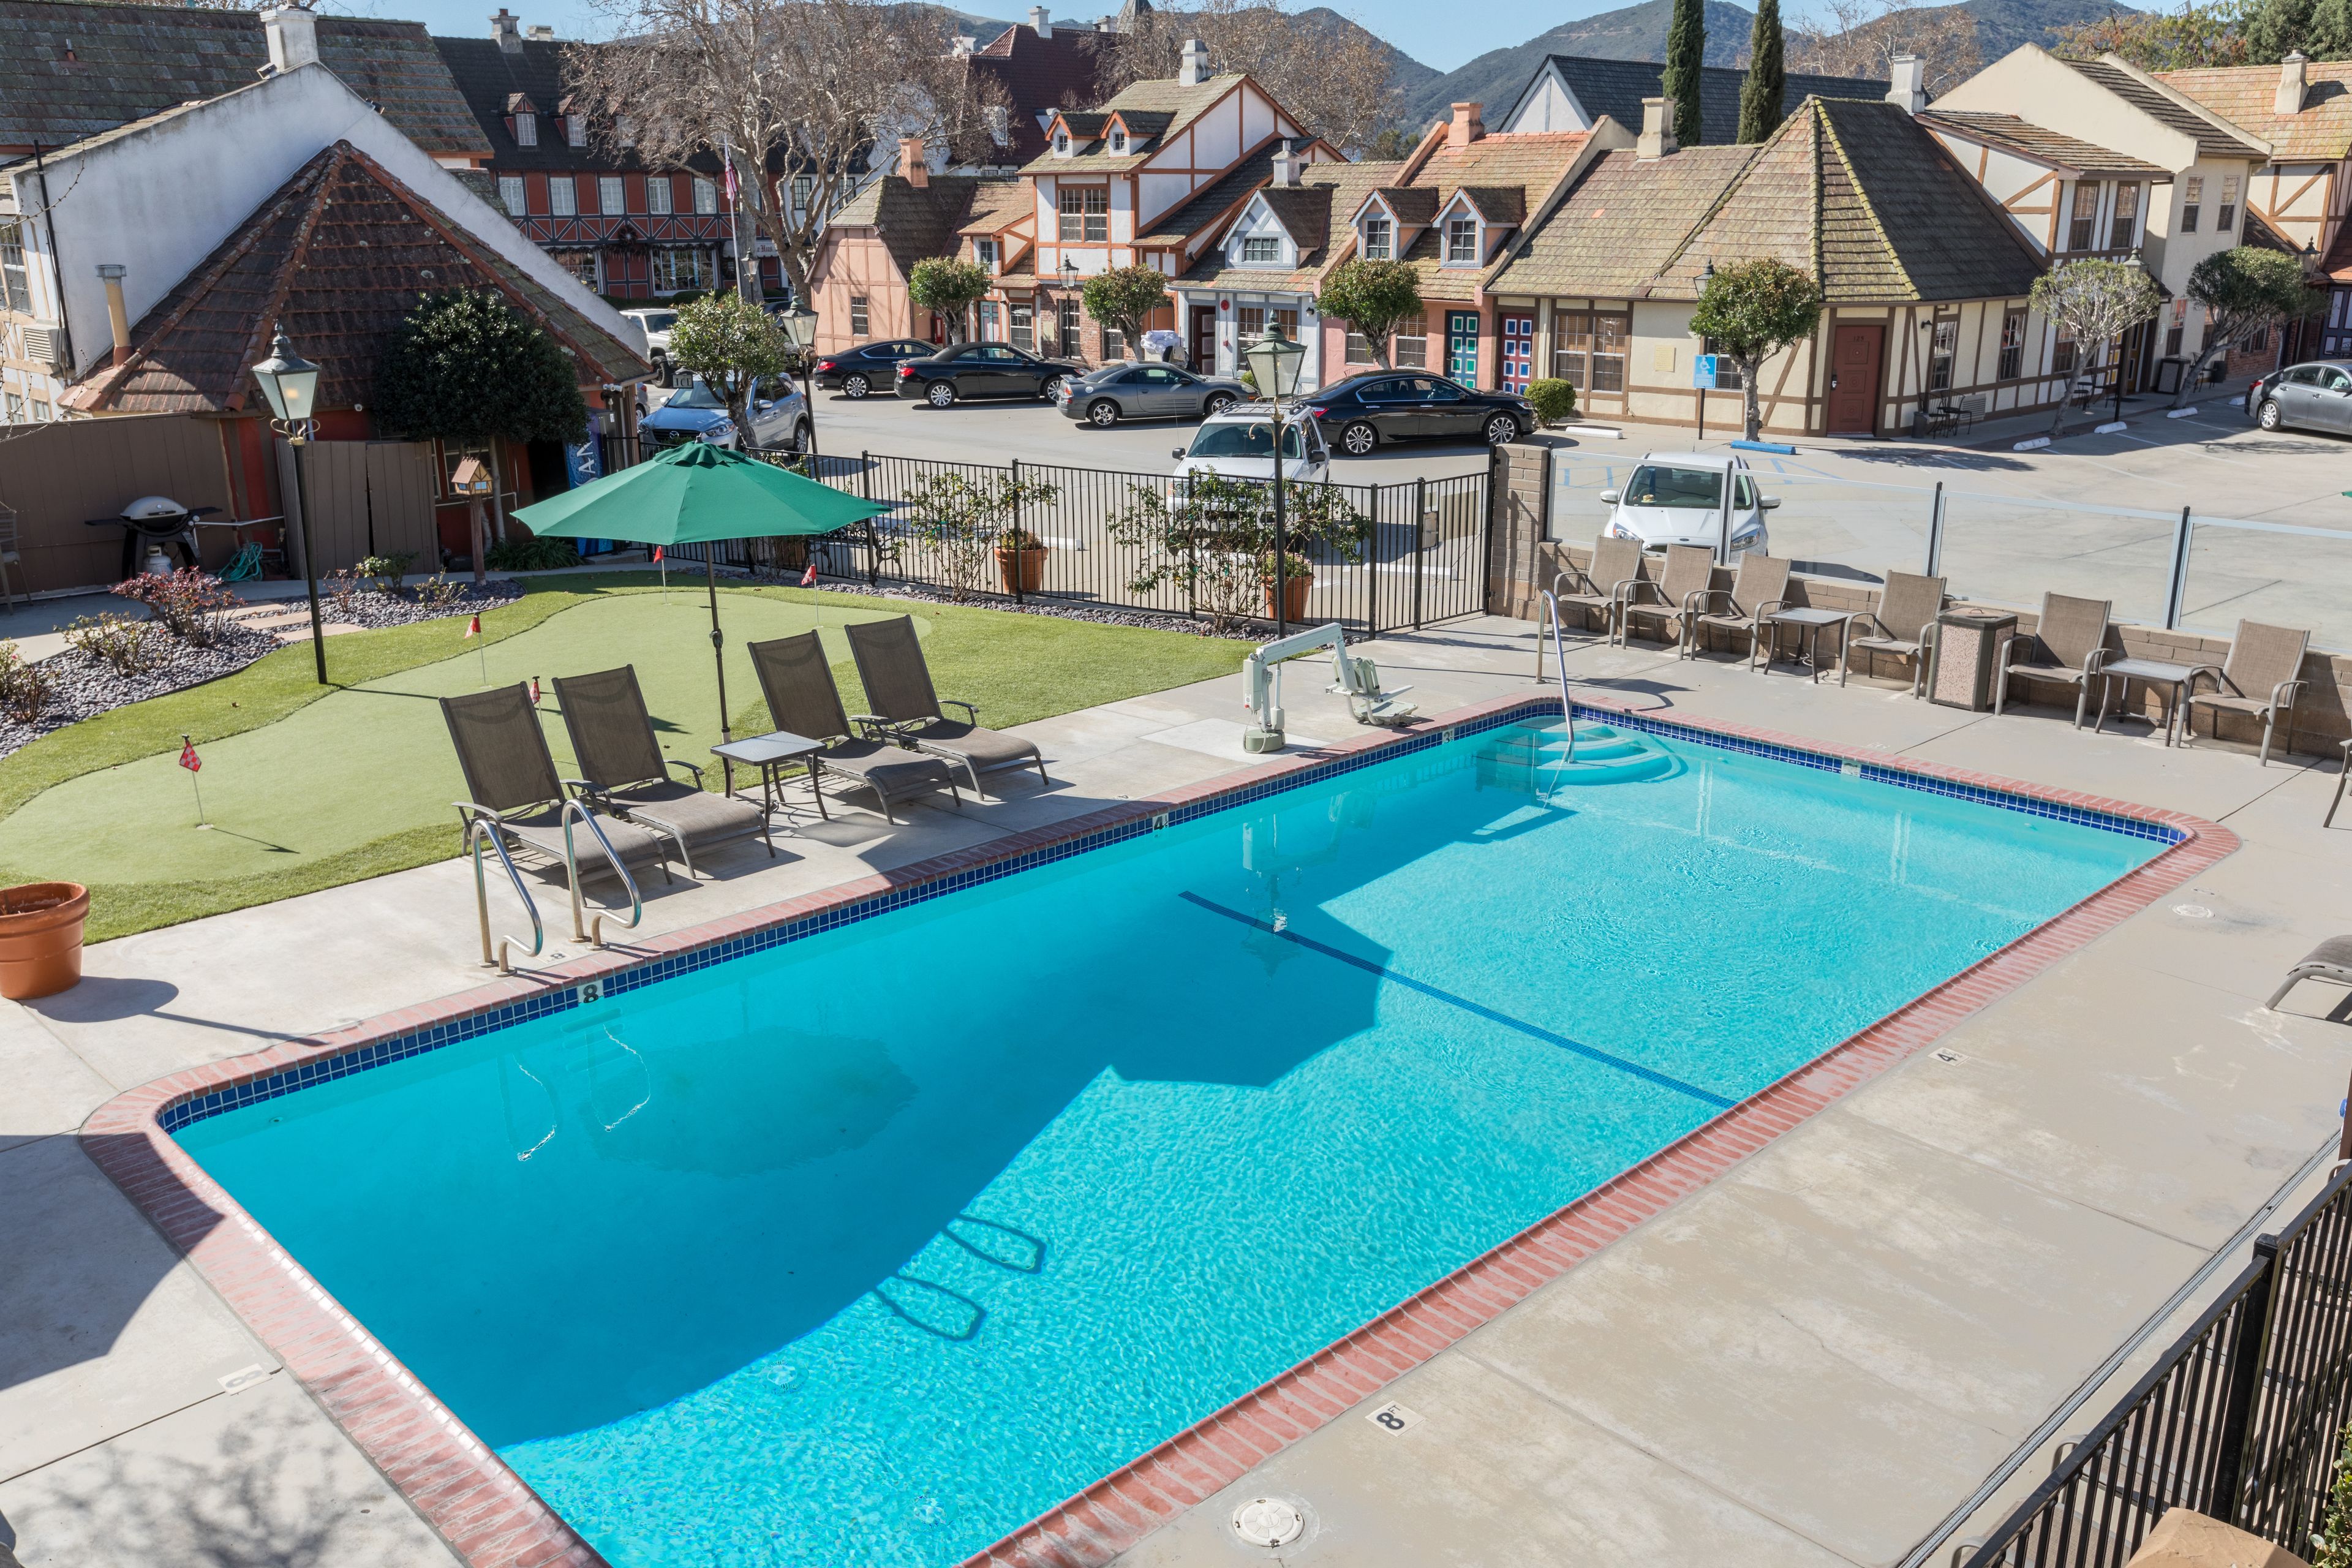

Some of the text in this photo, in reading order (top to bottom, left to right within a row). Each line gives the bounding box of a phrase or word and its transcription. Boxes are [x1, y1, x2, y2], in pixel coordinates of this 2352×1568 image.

[676, 378, 691, 386] ICE
[583, 984, 599, 1004] 8
[1376, 1412, 1405, 1430] 8
